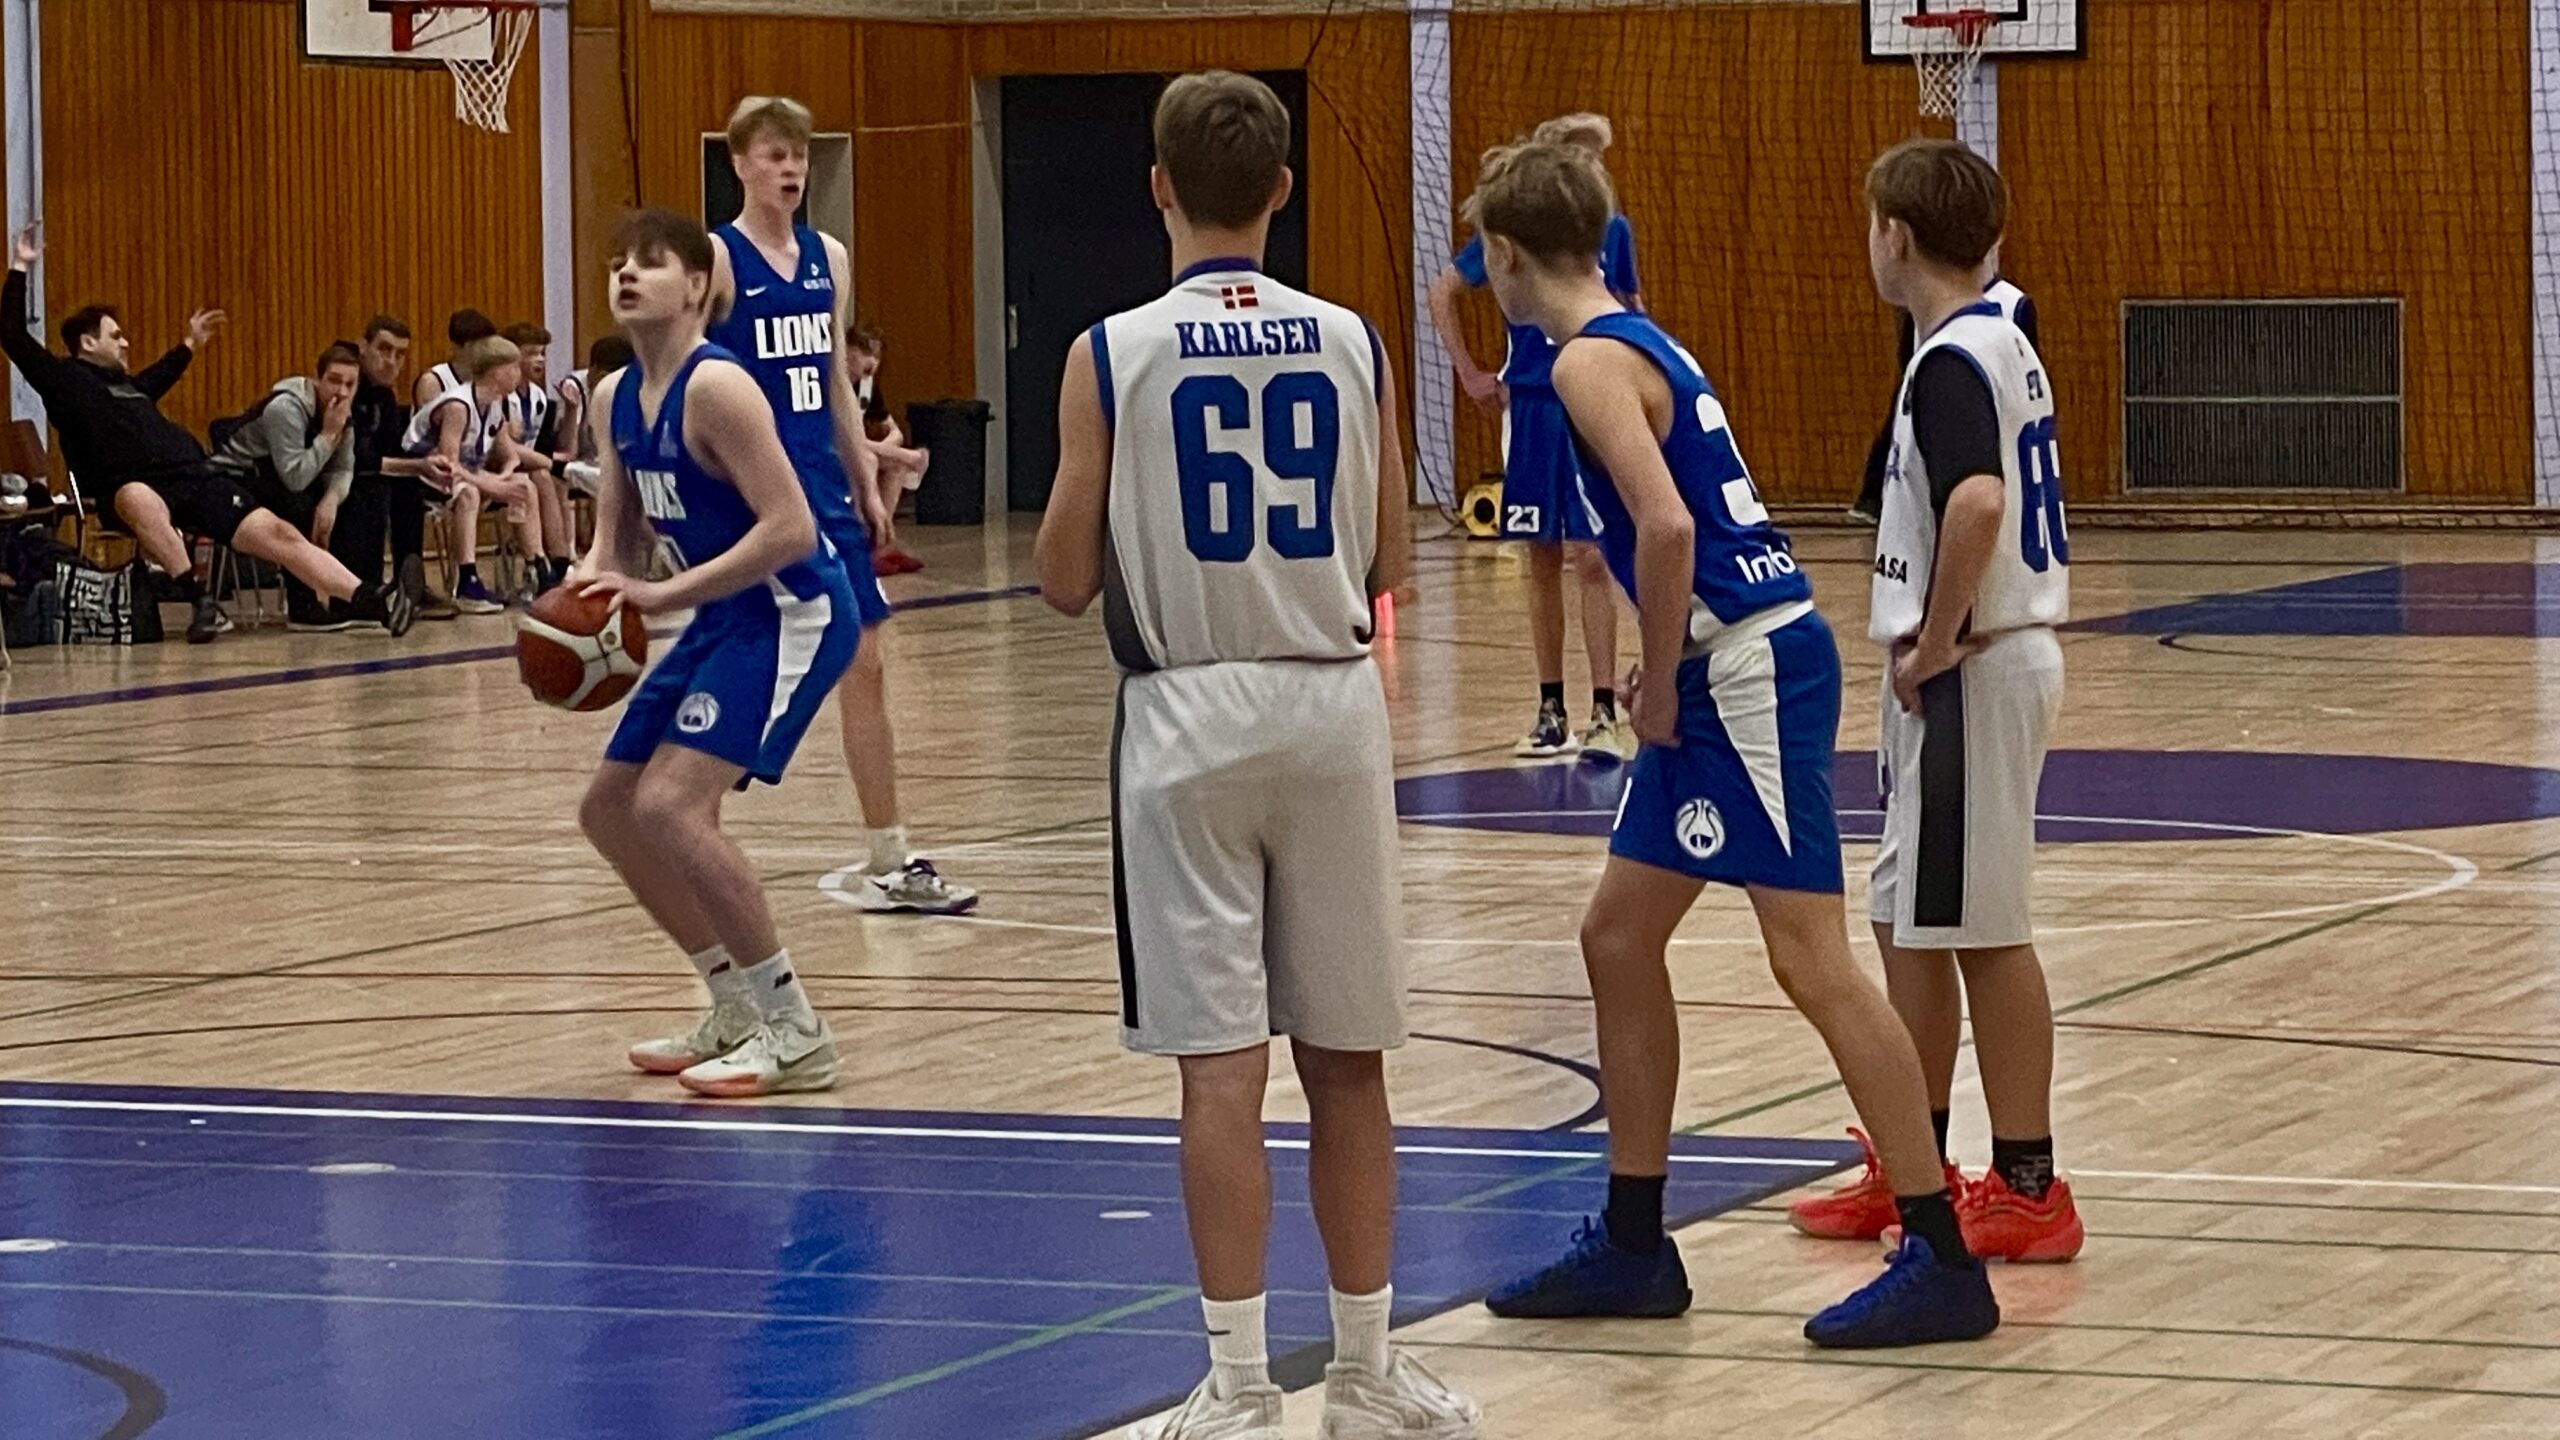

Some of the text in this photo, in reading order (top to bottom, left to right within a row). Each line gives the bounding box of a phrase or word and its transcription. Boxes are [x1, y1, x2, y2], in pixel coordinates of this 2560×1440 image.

[755, 312, 832, 360] LIONS
[1175, 317, 1322, 359] KARLSEN
[785, 366, 823, 412] 16
[1170, 371, 1340, 562] 69
[1507, 505, 1540, 532] 23
